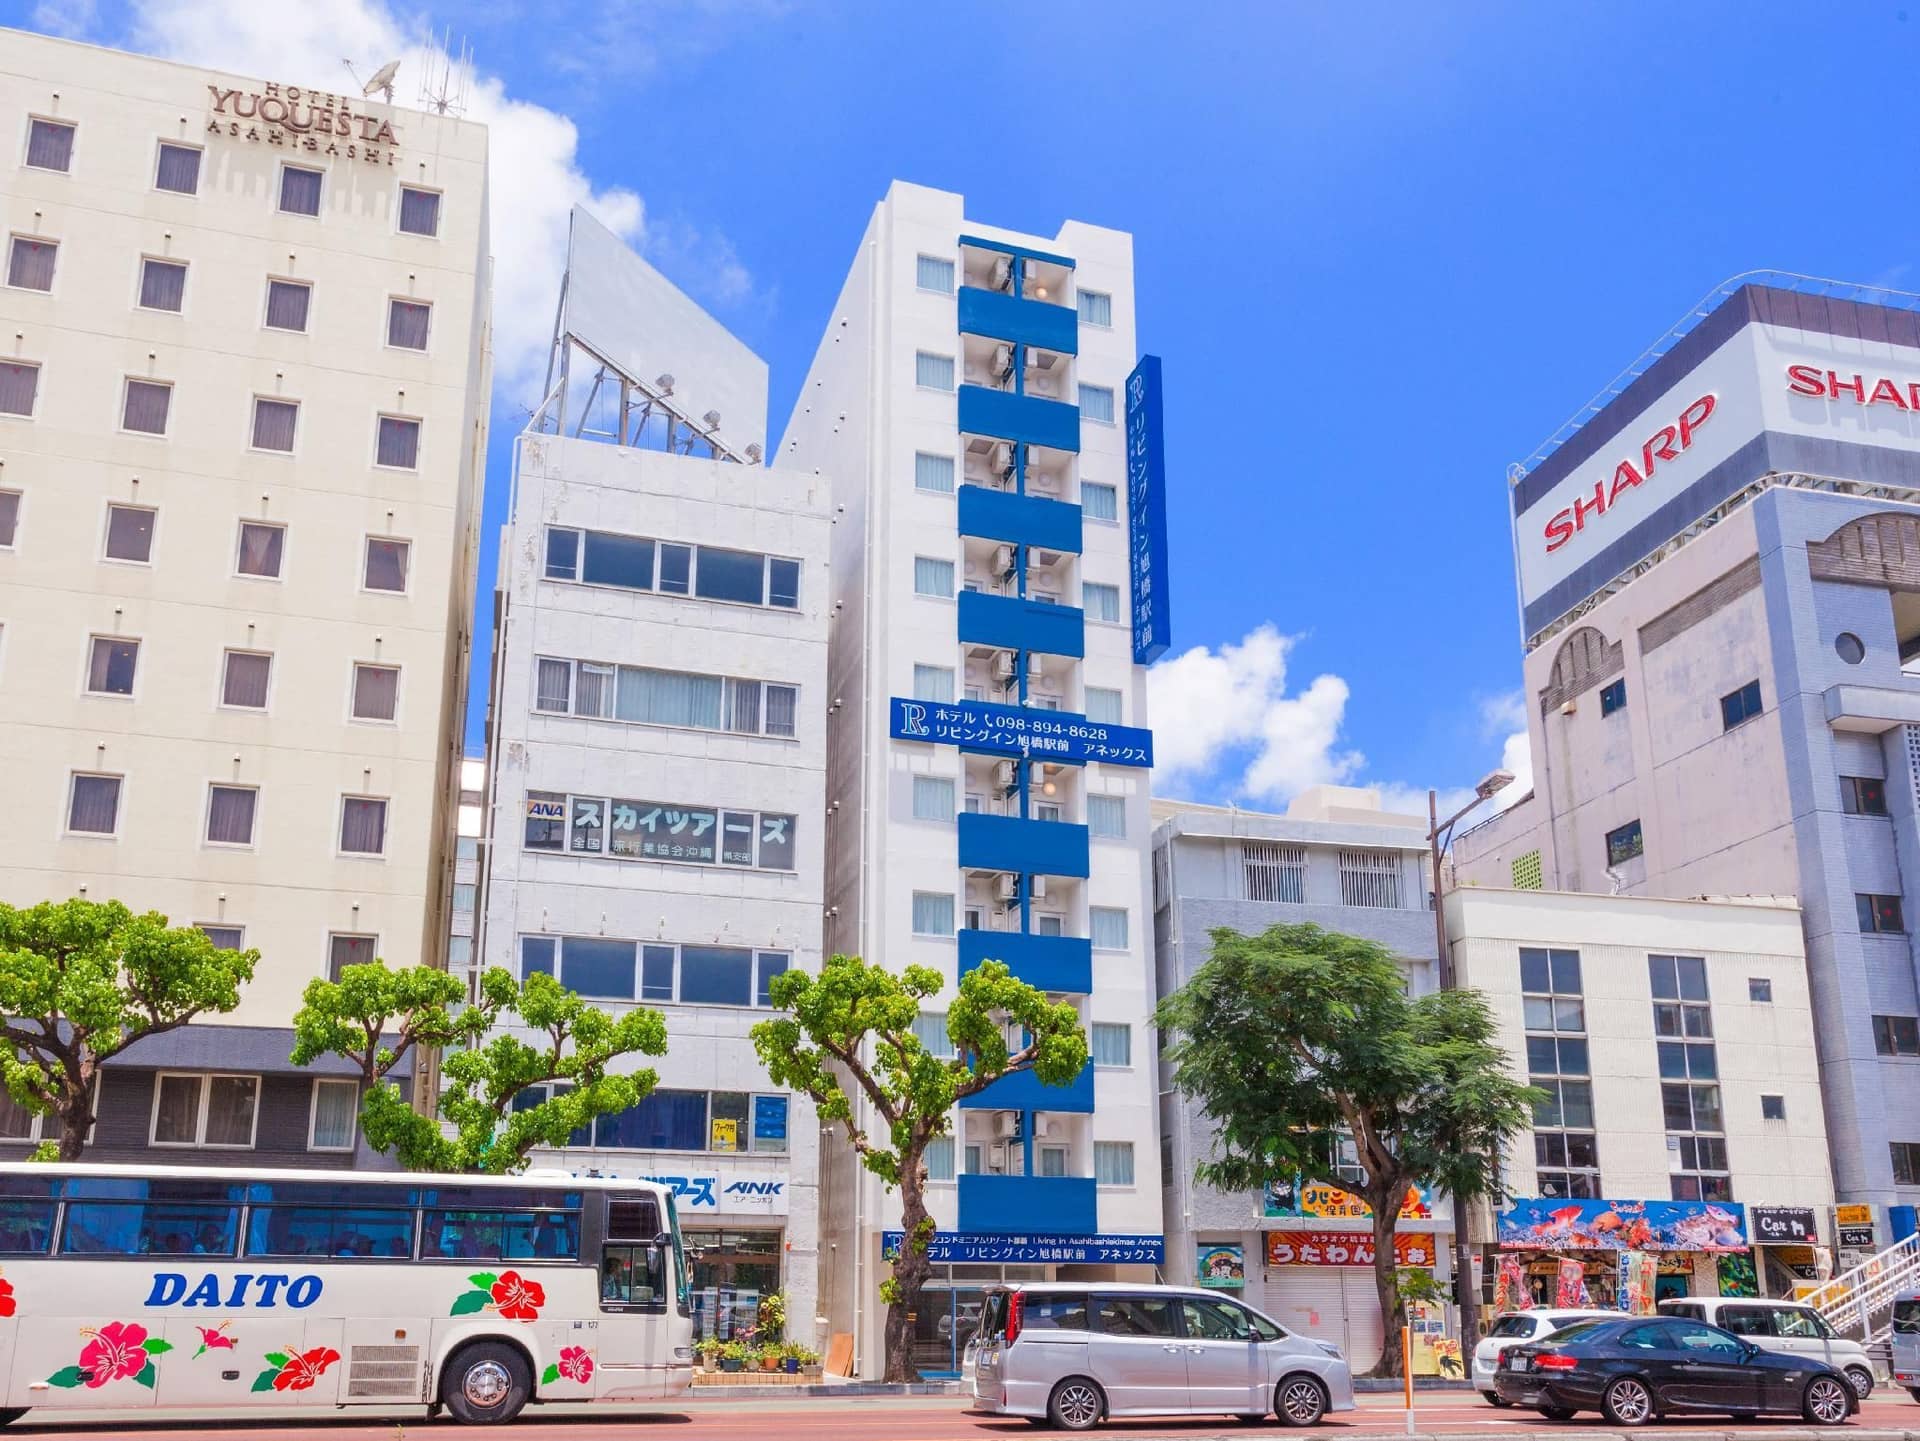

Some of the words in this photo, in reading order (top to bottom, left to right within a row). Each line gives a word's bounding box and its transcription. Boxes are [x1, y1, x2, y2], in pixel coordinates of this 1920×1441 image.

[265, 81, 349, 110] HOTEL
[207, 84, 400, 146] YUQUESTA
[207, 119, 395, 167] ASAHIBASHI
[1544, 393, 1718, 553] SHARP
[935, 709, 977, 725] ホテル
[996, 716, 1109, 740] 098-894-8628
[936, 725, 1070, 752] リビングイン旭橋駅前
[1082, 743, 1147, 761] アネックス
[528, 802, 564, 816] ANA
[575, 802, 790, 844] スカイツアーズ
[965, 1247, 1086, 1260] リビングイン旭橋駅前
[1099, 1249, 1157, 1260] アネックス
[143, 1273, 323, 1308] DAITO
